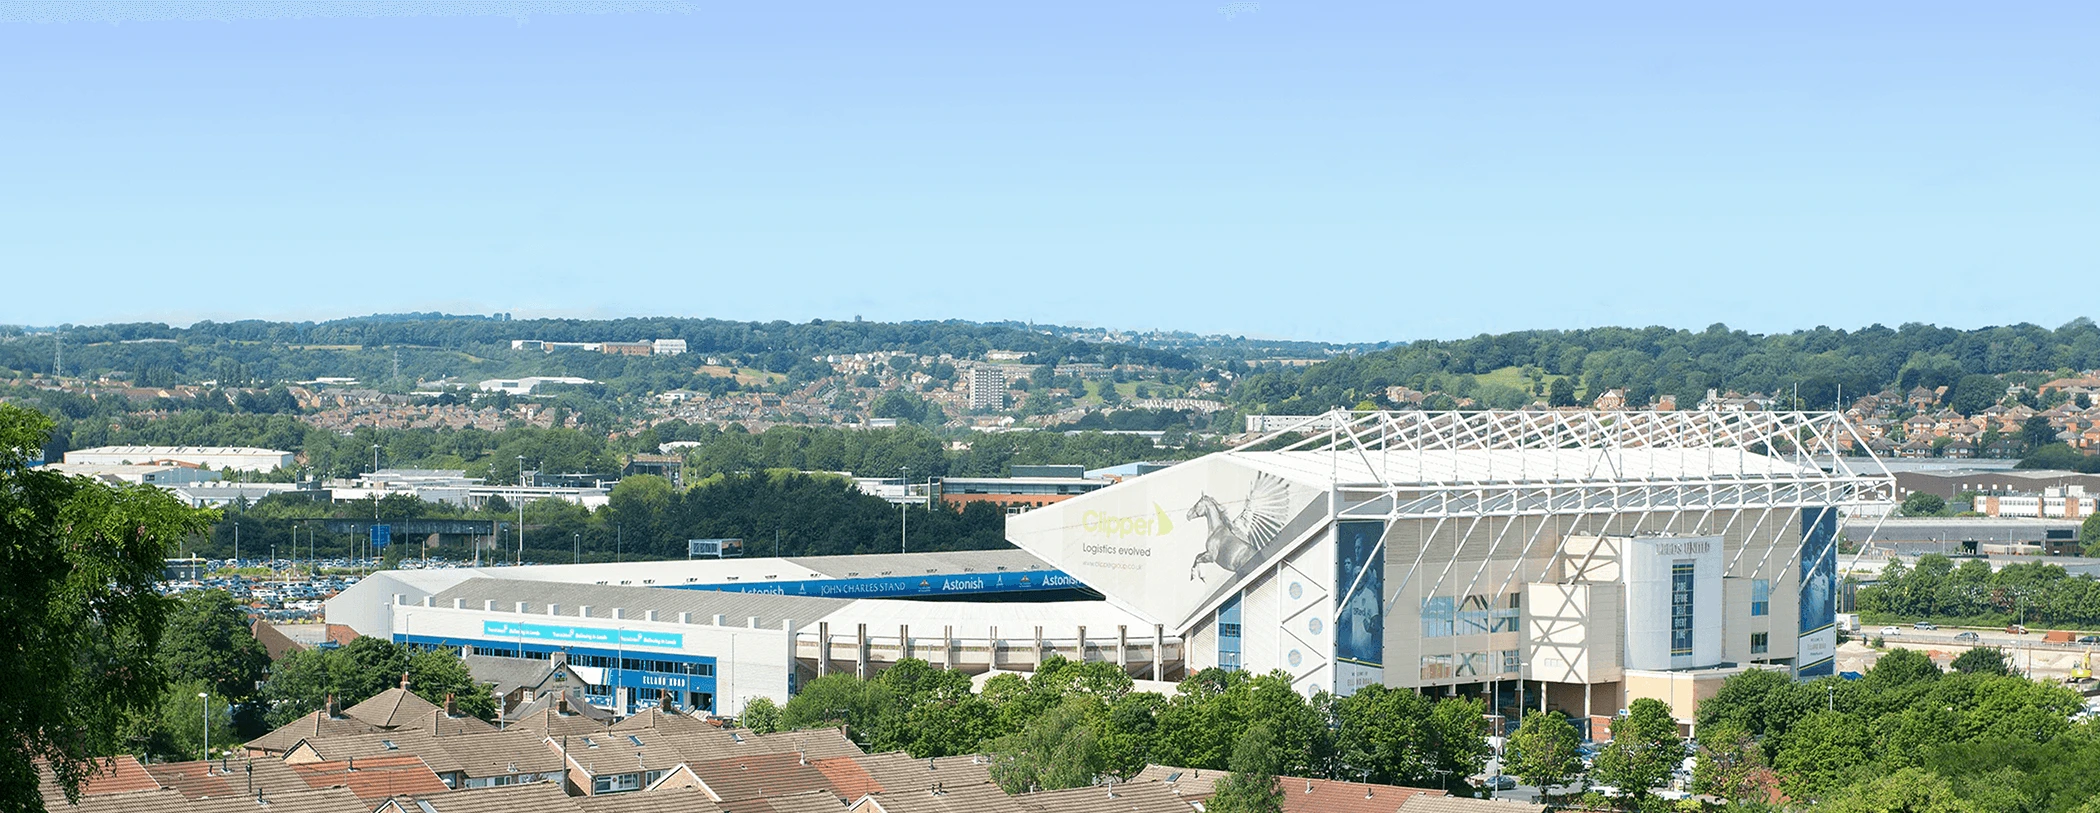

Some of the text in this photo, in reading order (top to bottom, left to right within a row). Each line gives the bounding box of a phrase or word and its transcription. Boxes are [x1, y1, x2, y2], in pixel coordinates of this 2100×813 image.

[1082, 509, 1155, 539] Clipper
[1082, 543, 1151, 557] Logistics evolved
[1656, 541, 1710, 555] LEEDS UNITED
[821, 585, 842, 596] JOHN
[843, 584, 878, 595] CHARLES
[879, 582, 906, 592] STAND
[942, 577, 983, 591] Astonish
[642, 676, 685, 687] ELLAND ROAD
